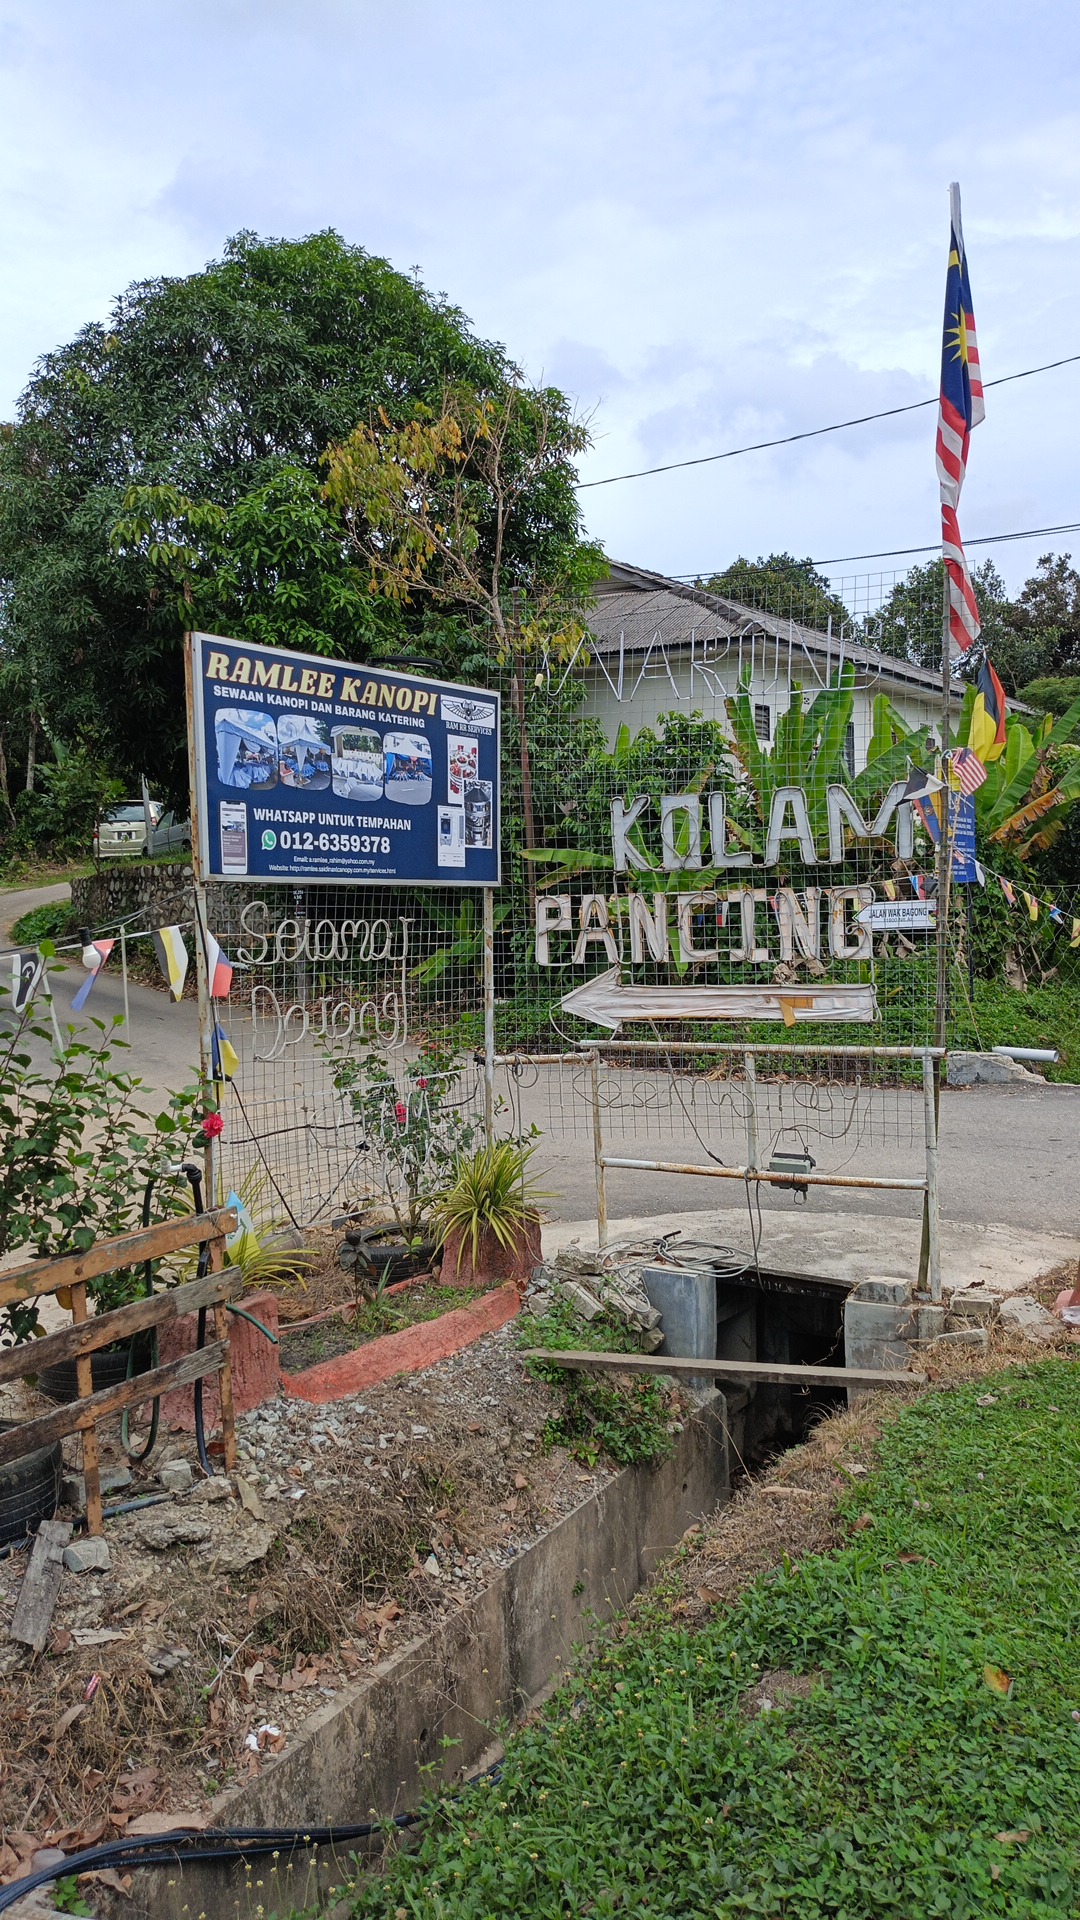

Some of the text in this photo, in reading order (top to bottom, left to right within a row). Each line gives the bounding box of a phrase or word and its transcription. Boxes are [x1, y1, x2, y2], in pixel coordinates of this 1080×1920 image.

[206, 651, 439, 716] RAMLEE KANOPI
[213, 685, 426, 728] SEWAAN KANOPI DAN BARANG KATERING
[445, 720, 459, 731] RAM
[467, 725, 493, 736] SERVICES
[253, 808, 412, 831] WHATSAPP UNTUK TEMPAHAN
[610, 780, 914, 873] KOLAM
[279, 830, 391, 854] 012-6359378
[268, 864, 289, 872] Website:
[869, 907, 927, 918] JALAN WAK BAGONG
[535, 884, 876, 967] PANCING
